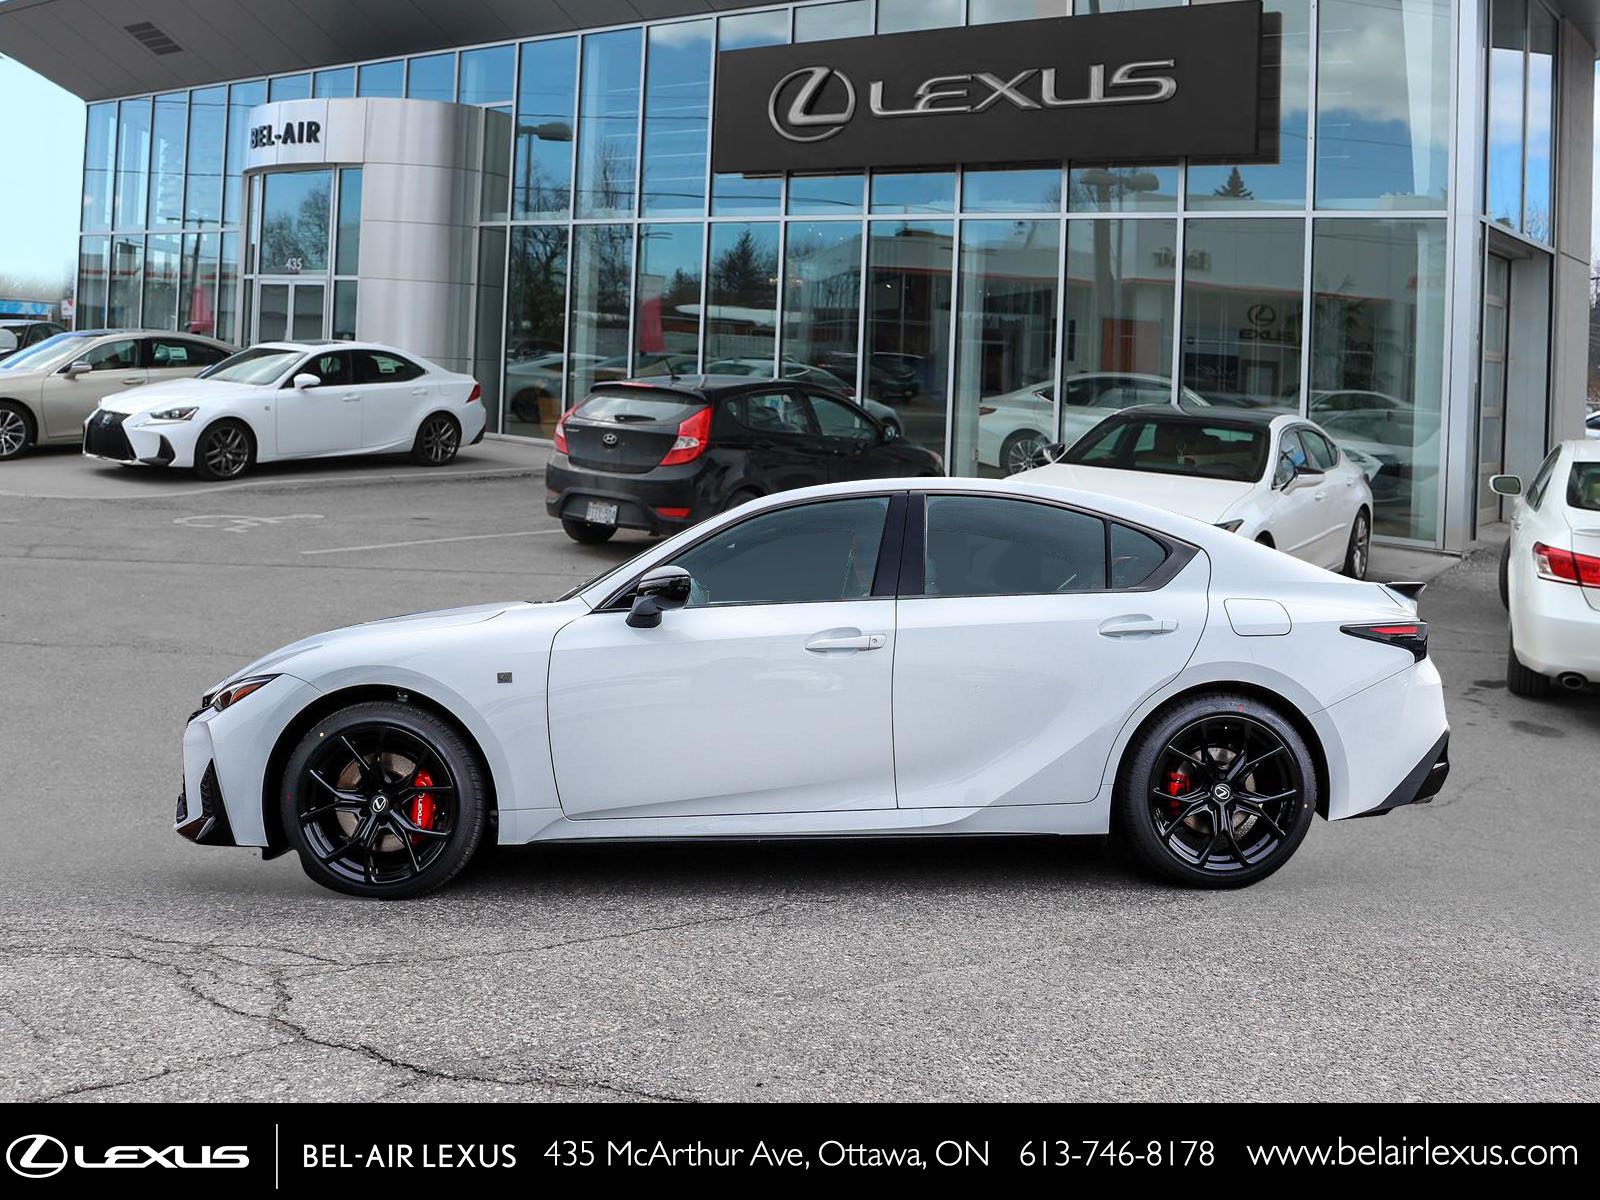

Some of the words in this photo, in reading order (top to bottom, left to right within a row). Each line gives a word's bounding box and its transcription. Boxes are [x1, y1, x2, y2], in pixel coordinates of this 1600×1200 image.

[869, 59, 1177, 118] LEXUS
[250, 121, 320, 149] BEL-AIR
[286, 257, 302, 270] 435
